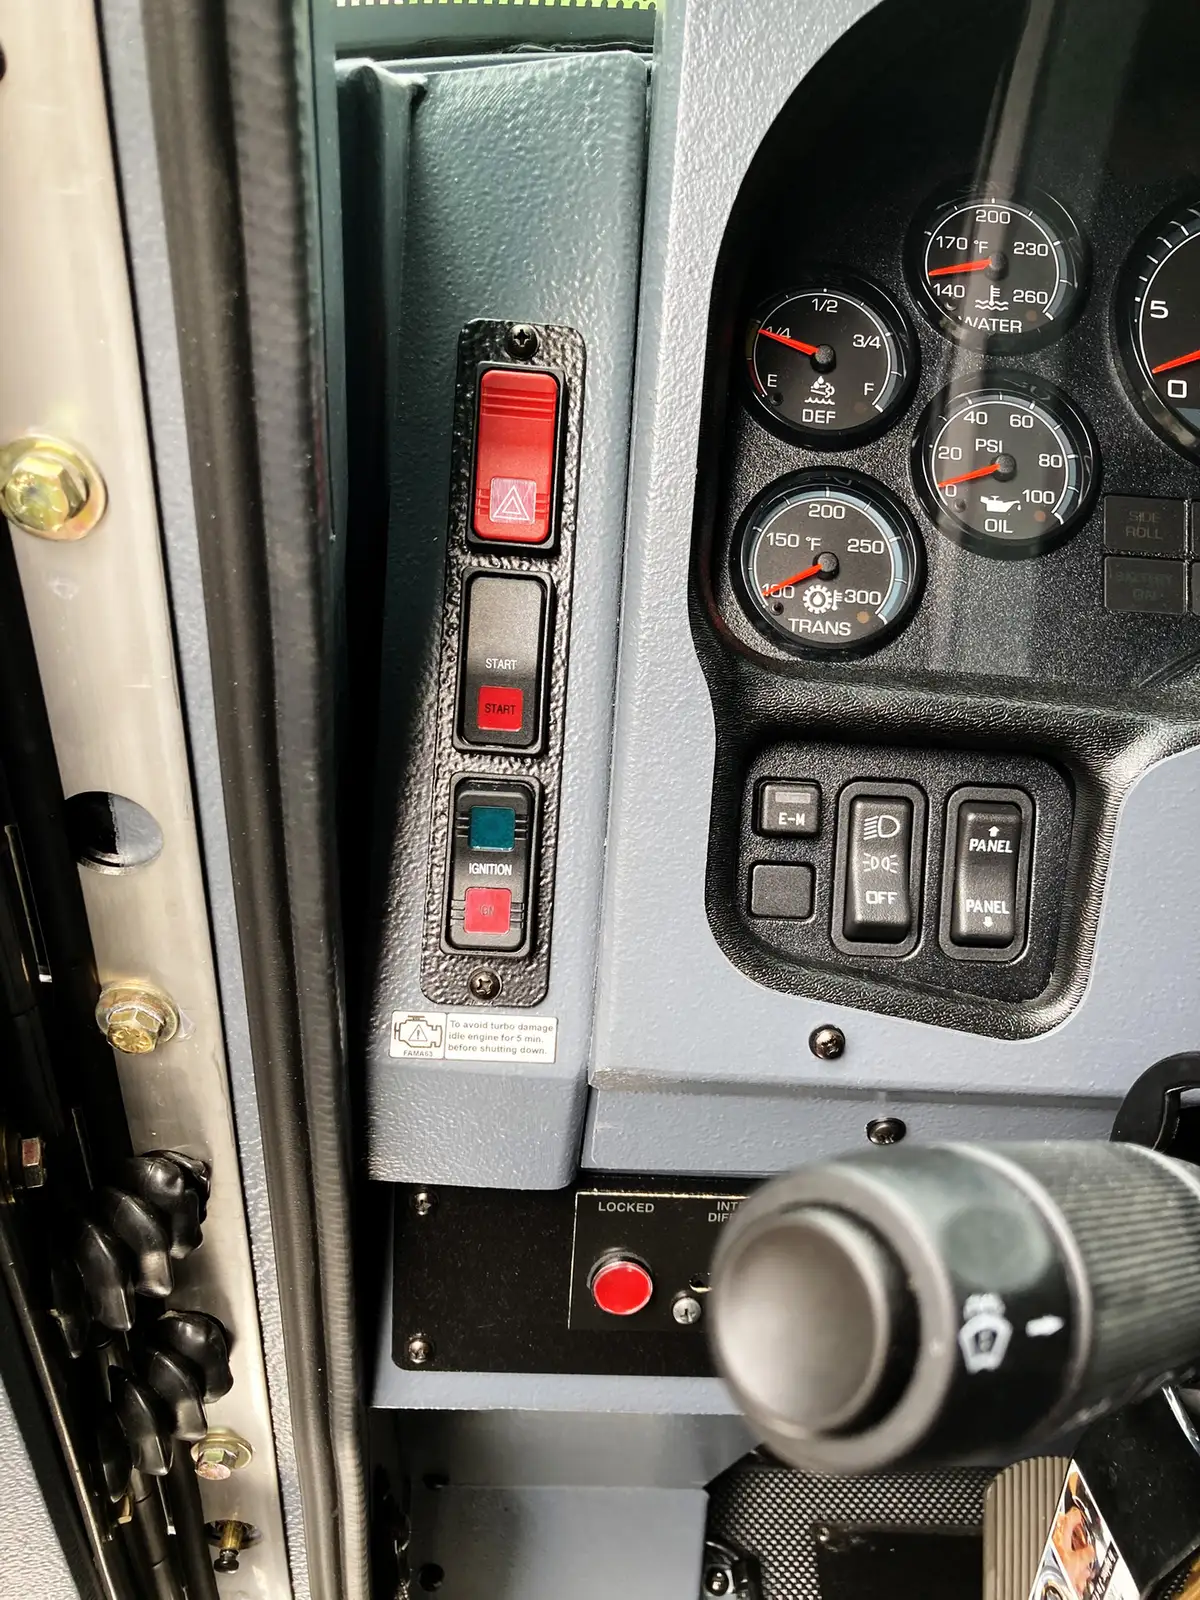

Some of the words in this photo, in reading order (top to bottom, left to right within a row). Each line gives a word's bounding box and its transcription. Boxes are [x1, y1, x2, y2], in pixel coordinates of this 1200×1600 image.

[975, 209, 1011, 224] 200
[935, 236, 968, 250] 170
[1013, 241, 1049, 257] 230
[933, 283, 965, 298] 140
[1012, 289, 1048, 305] 260
[811, 298, 838, 313] 1/2
[1150, 300, 1169, 319] 5
[958, 315, 1022, 333] WATER
[852, 334, 881, 350] 3/4
[767, 374, 777, 388] E
[1167, 379, 1188, 398] 0
[864, 383, 875, 396] F
[801, 409, 836, 424] DEF
[963, 411, 988, 425] 40
[1009, 414, 1034, 429] 60
[938, 446, 962, 461] 20
[975, 439, 1003, 453] PSI
[1038, 453, 1063, 468] 80
[945, 484, 957, 498] 0
[1022, 489, 1055, 504] 100
[808, 503, 846, 520] 200
[984, 518, 1014, 533] OIL
[766, 532, 800, 548] 150
[847, 538, 884, 554] 250
[844, 589, 882, 606] 300
[788, 618, 852, 636] TRANS
[485, 658, 517, 670] START
[484, 702, 516, 716] START
[778, 812, 805, 826] E-M
[968, 838, 1013, 854] PANEL
[468, 862, 512, 876] IGNITION
[865, 890, 897, 905] OFF
[965, 899, 1010, 914] PANEL
[450, 1020, 460, 1029] To
[463, 1021, 488, 1029] avoid
[491, 1022, 515, 1030] turbo
[518, 1023, 554, 1033] damage
[448, 1032, 465, 1040] idle
[468, 1034, 499, 1042] engine
[517, 1034, 522, 1042] 5
[448, 1043, 477, 1052] before
[480, 1045, 517, 1055] shutting
[520, 1046, 547, 1054] down.
[598, 1201, 655, 1213] LOCKED
[717, 1201, 742, 1211] INT
